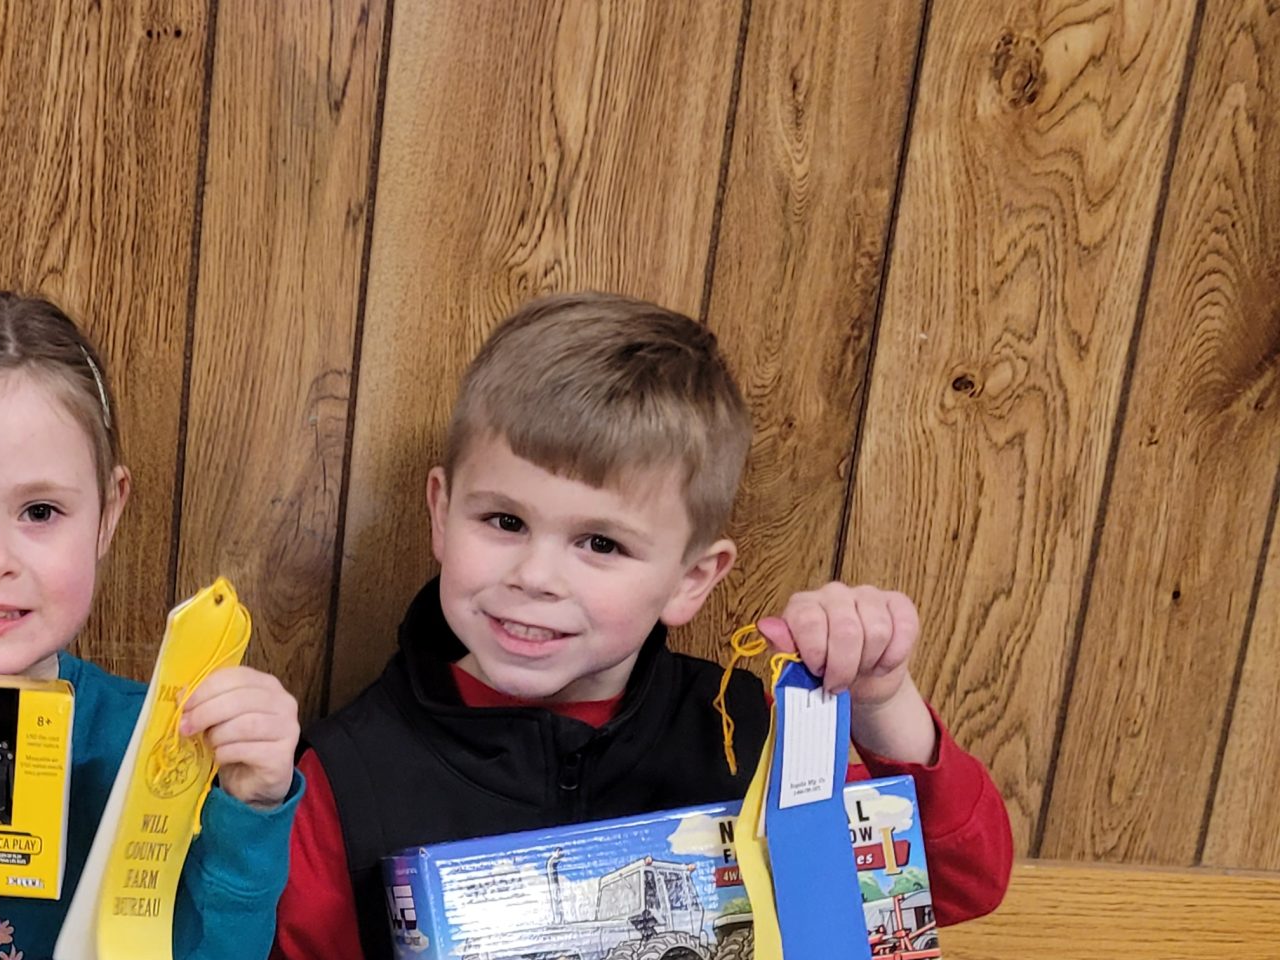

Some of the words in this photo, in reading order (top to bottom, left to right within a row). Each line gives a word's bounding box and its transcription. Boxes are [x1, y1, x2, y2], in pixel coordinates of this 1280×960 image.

[36, 715, 52, 727] 8+
[141, 814, 168, 834] WILL
[12, 839, 37, 851] PLAY
[124, 841, 172, 862] COUNTY
[123, 869, 160, 889] FARM
[113, 897, 161, 917] BUREAU
